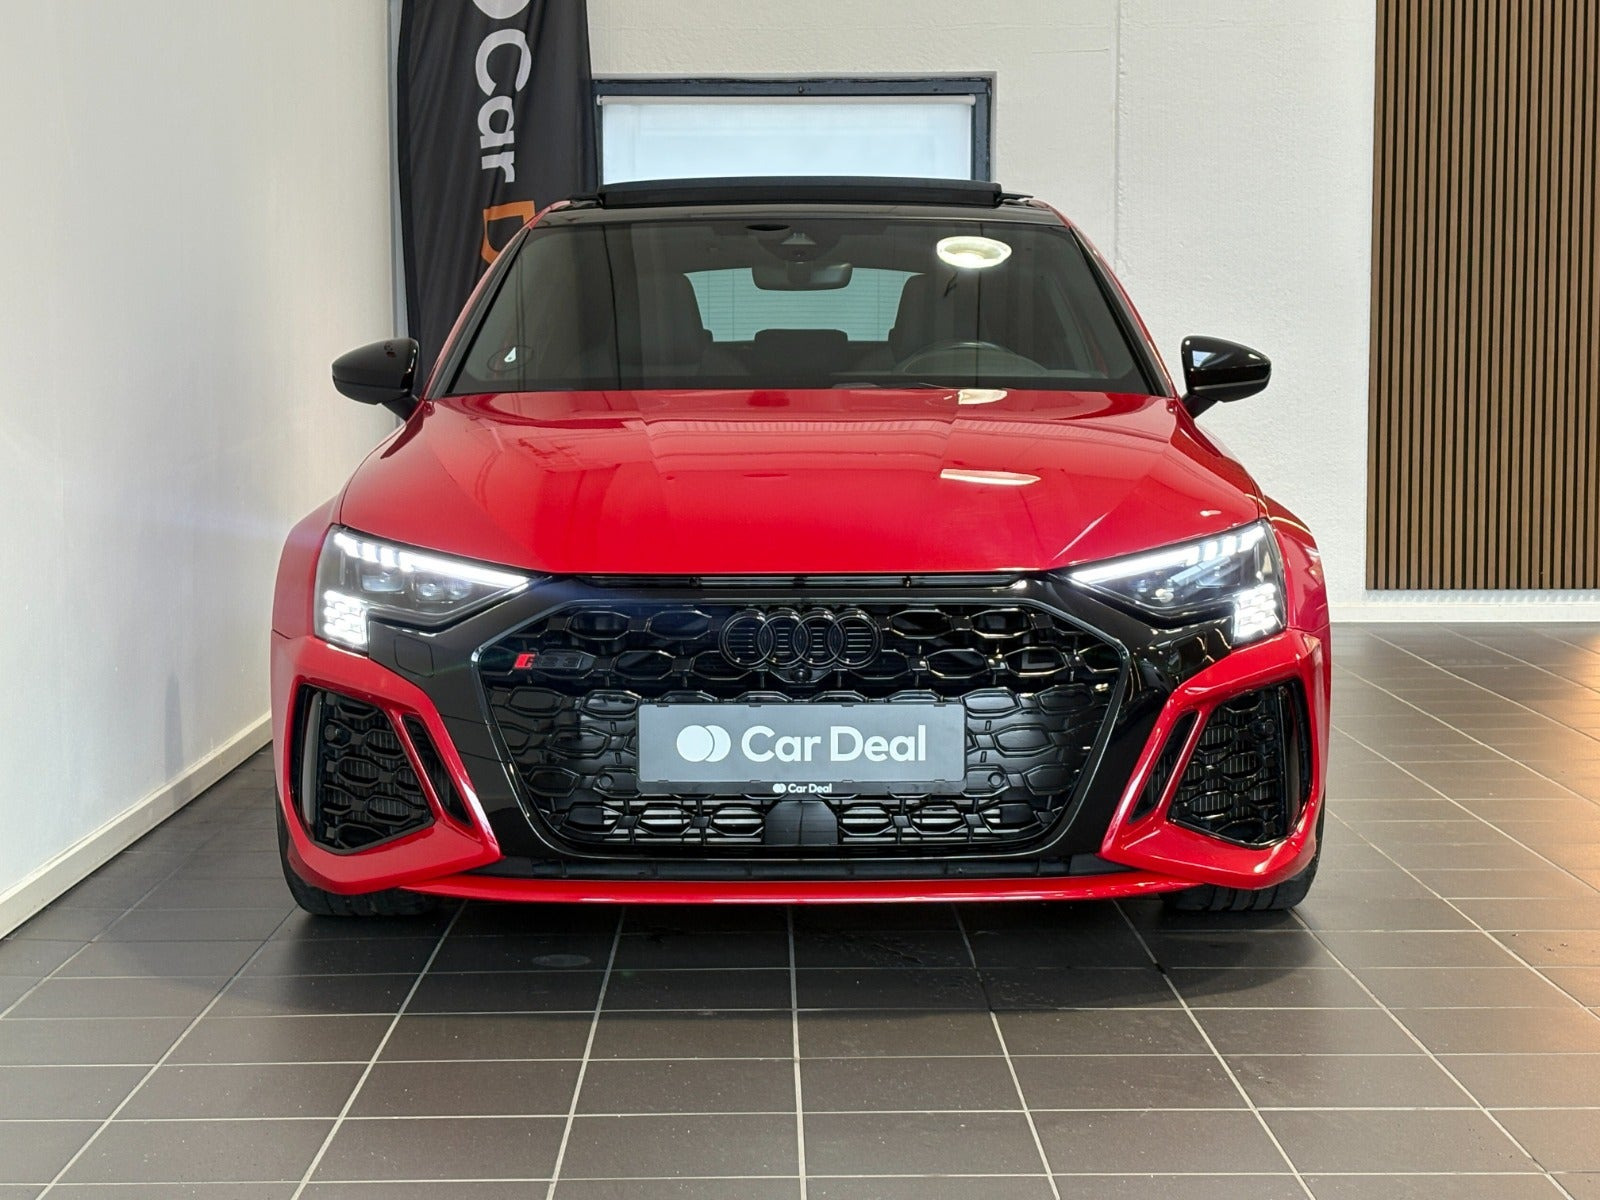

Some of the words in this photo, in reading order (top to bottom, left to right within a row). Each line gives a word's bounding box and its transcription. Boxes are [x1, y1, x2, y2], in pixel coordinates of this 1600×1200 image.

[475, 28, 532, 183] Car
[741, 725, 822, 763] Car
[830, 724, 926, 762] Deal
[787, 783, 808, 794] Car
[808, 782, 833, 794] Deal
